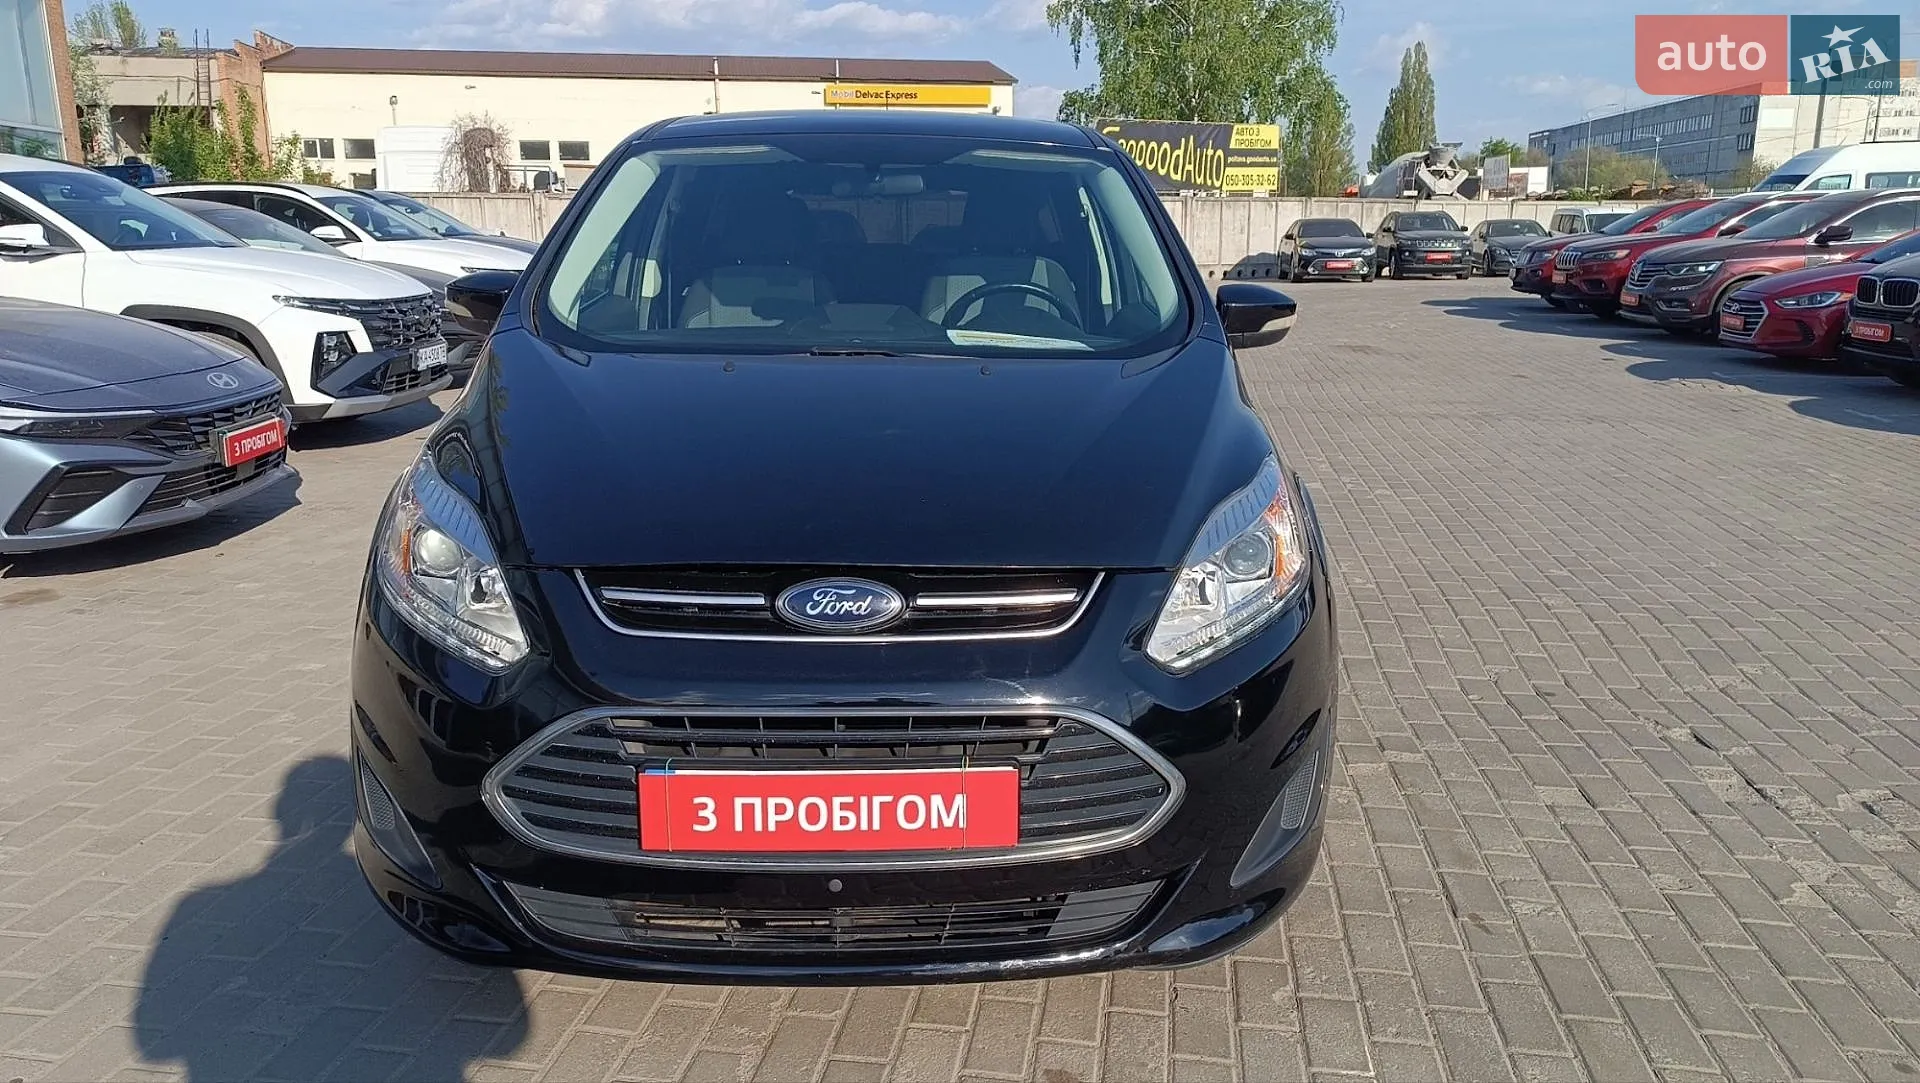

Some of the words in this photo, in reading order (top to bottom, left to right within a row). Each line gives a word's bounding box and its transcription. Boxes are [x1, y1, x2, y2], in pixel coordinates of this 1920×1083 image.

[831, 90, 854, 98] Mobil
[855, 90, 884, 99] Delvac
[885, 90, 918, 100] Express
[1235, 127, 1255, 137] АВТО
[1234, 138, 1272, 148] ПРОБІГОМ
[1225, 174, 1276, 186] 050-305-32-62
[234, 442, 240, 457] З
[241, 428, 278, 455] ПРОБІГОМ
[806, 588, 873, 615] Ford
[692, 796, 717, 832] З
[733, 794, 967, 832] ПРОБІГОМ
